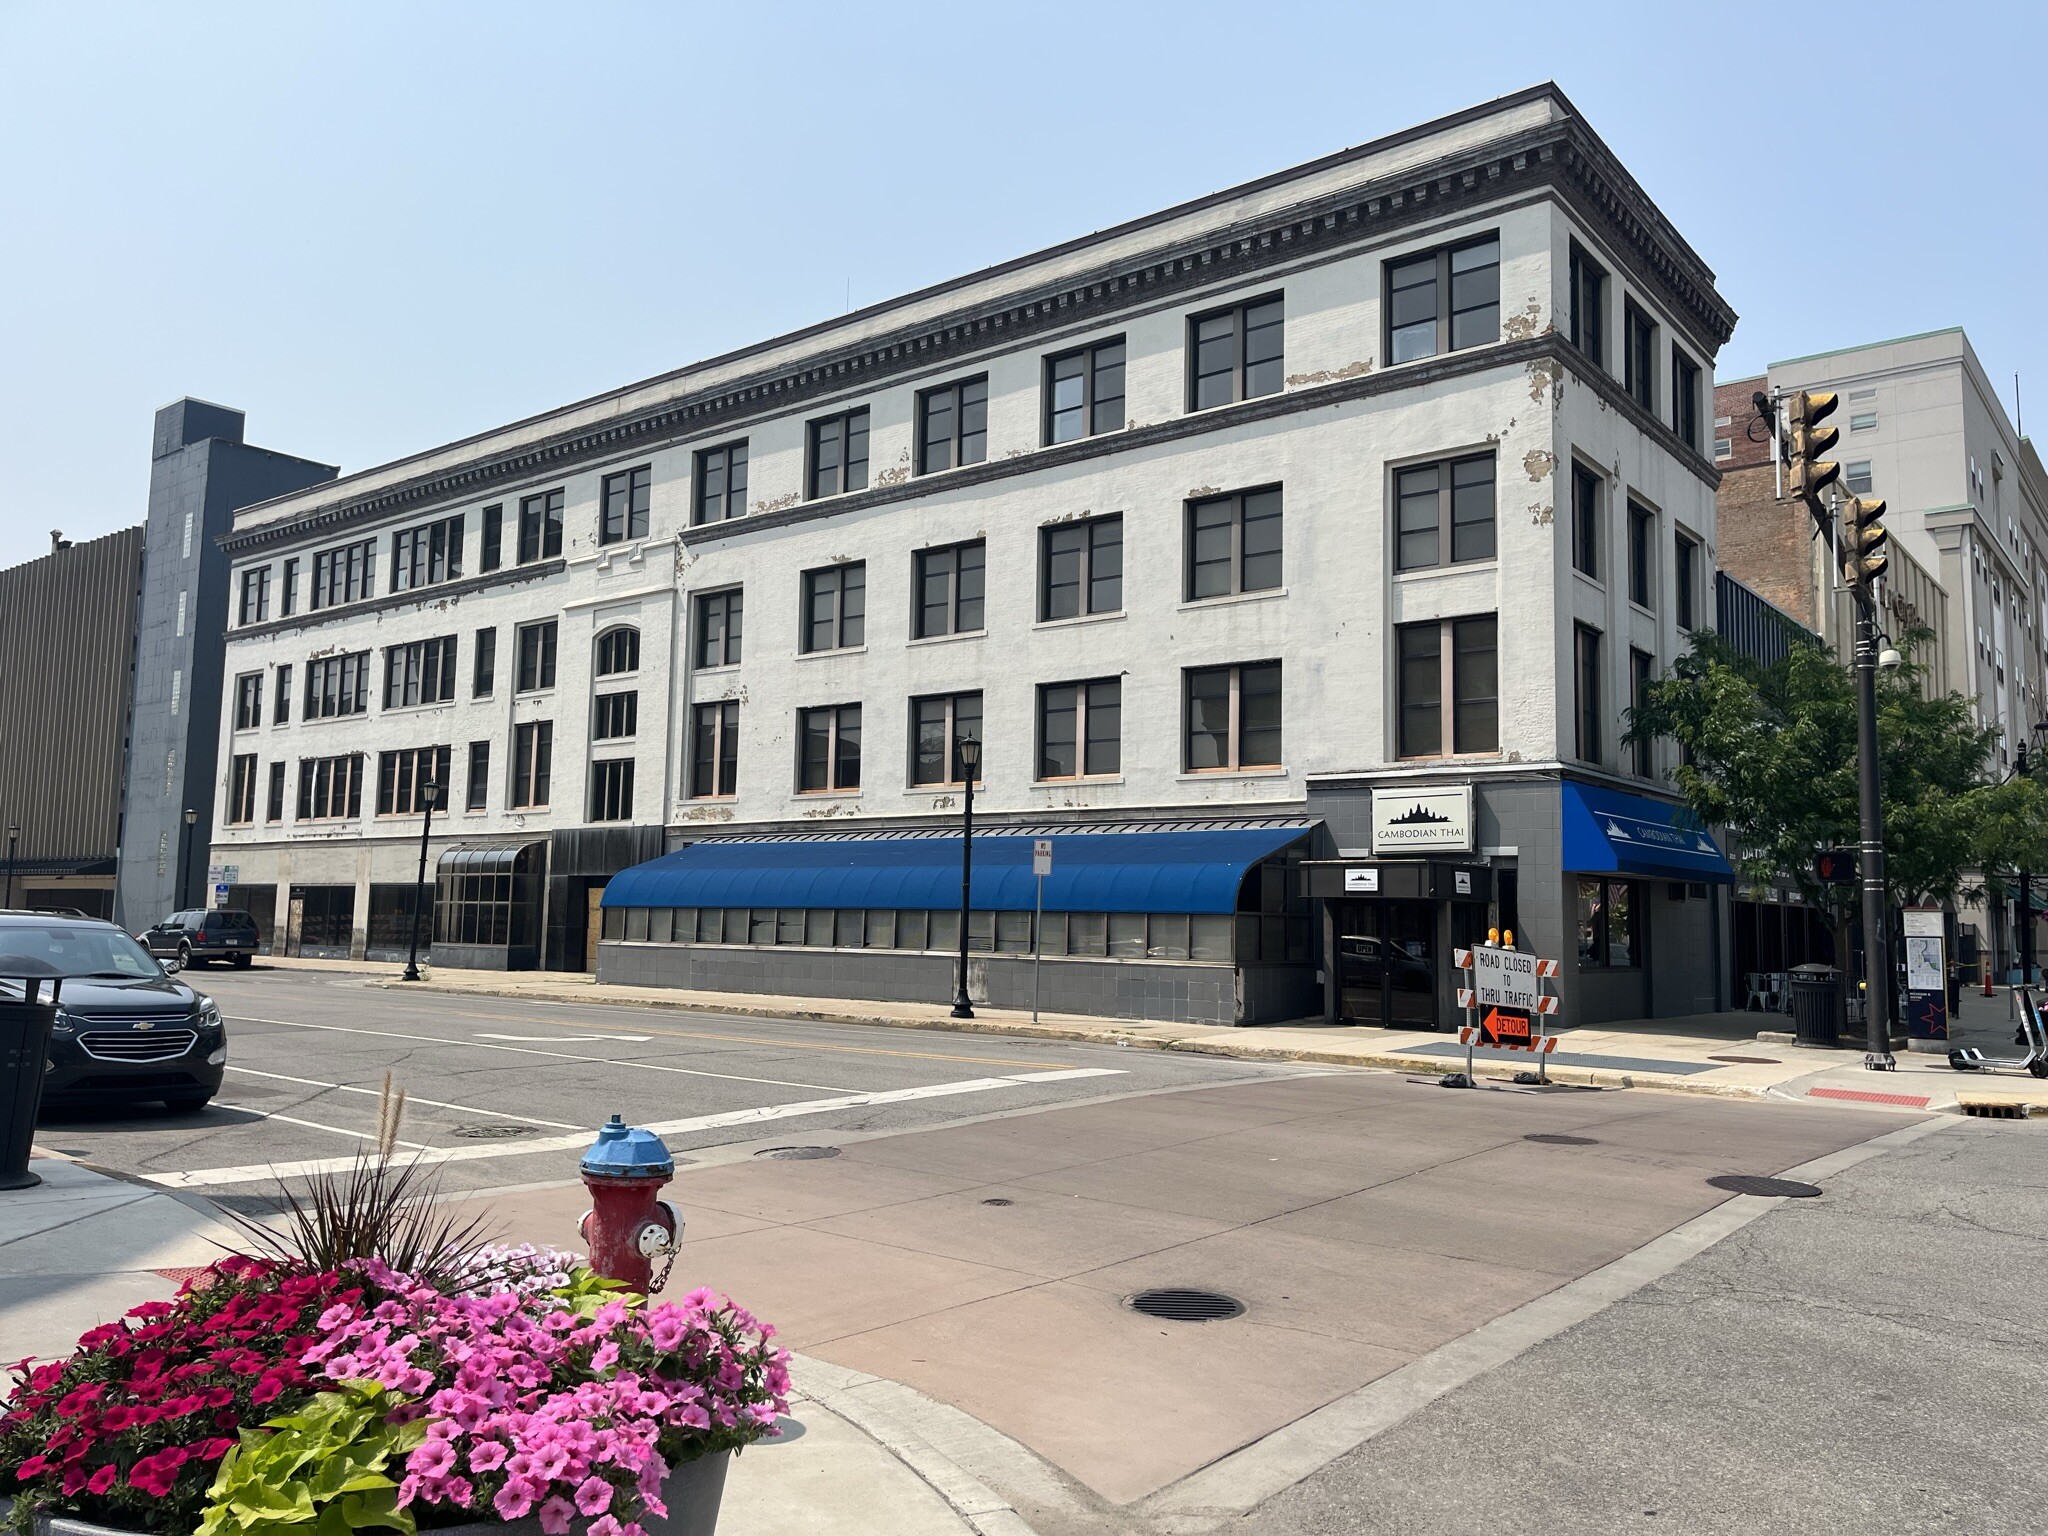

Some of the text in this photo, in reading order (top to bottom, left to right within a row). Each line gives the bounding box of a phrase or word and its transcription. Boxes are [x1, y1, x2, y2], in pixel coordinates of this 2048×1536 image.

[1377, 828, 1464, 838] CAMBODIAN THAI
[1357, 945, 1372, 953] OPEN
[1480, 953, 1532, 974] ROAD CLOSED
[1503, 974, 1511, 986] TO
[1481, 987, 1533, 1007] THRU TRAFFIC
[1496, 1017, 1527, 1034] DETOUR
